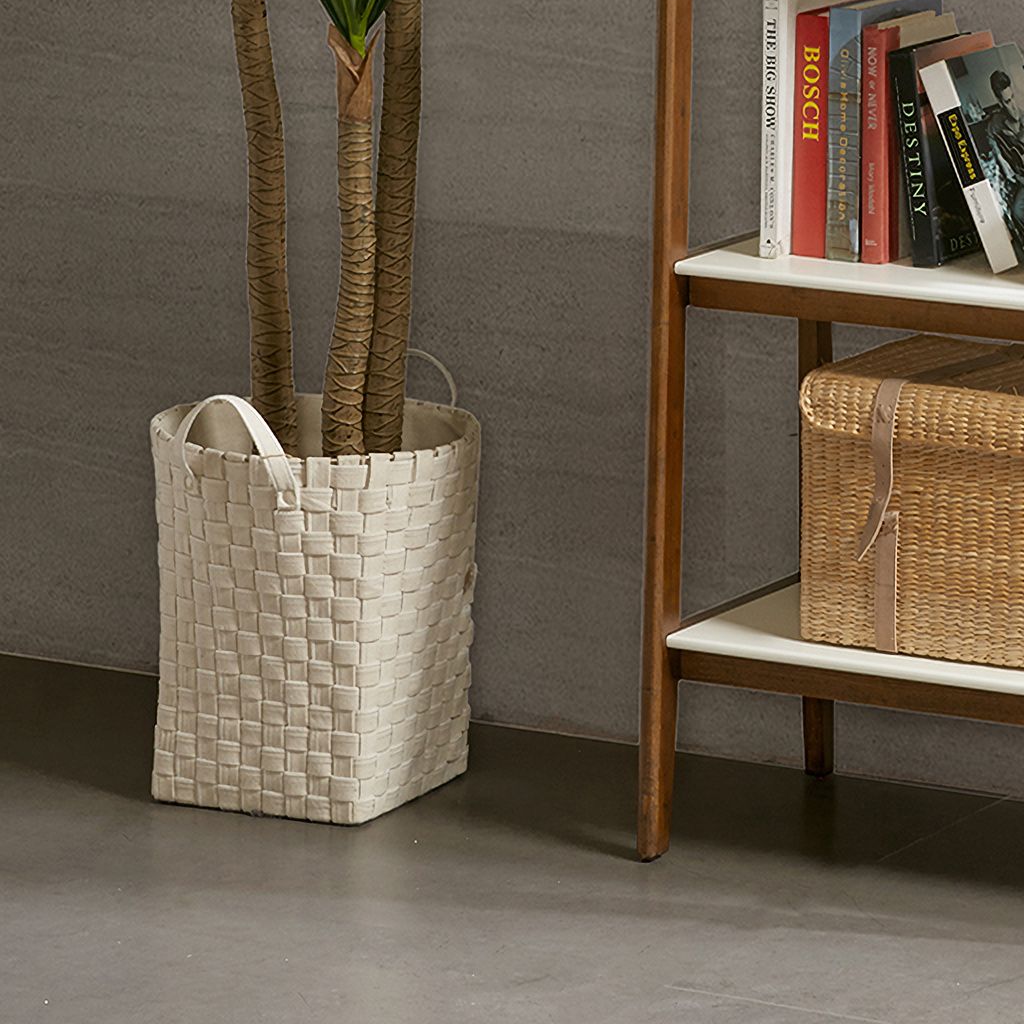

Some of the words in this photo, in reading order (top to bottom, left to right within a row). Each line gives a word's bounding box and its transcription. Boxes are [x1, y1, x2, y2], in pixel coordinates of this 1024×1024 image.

[766, 19, 777, 51] THE
[766, 55, 777, 81] BIG
[867, 46, 878, 77] NOW
[765, 86, 777, 131] SHOW
[803, 45, 820, 142] BOSCH
[867, 92, 878, 131] NEVER
[902, 102, 928, 215] DESTINY
